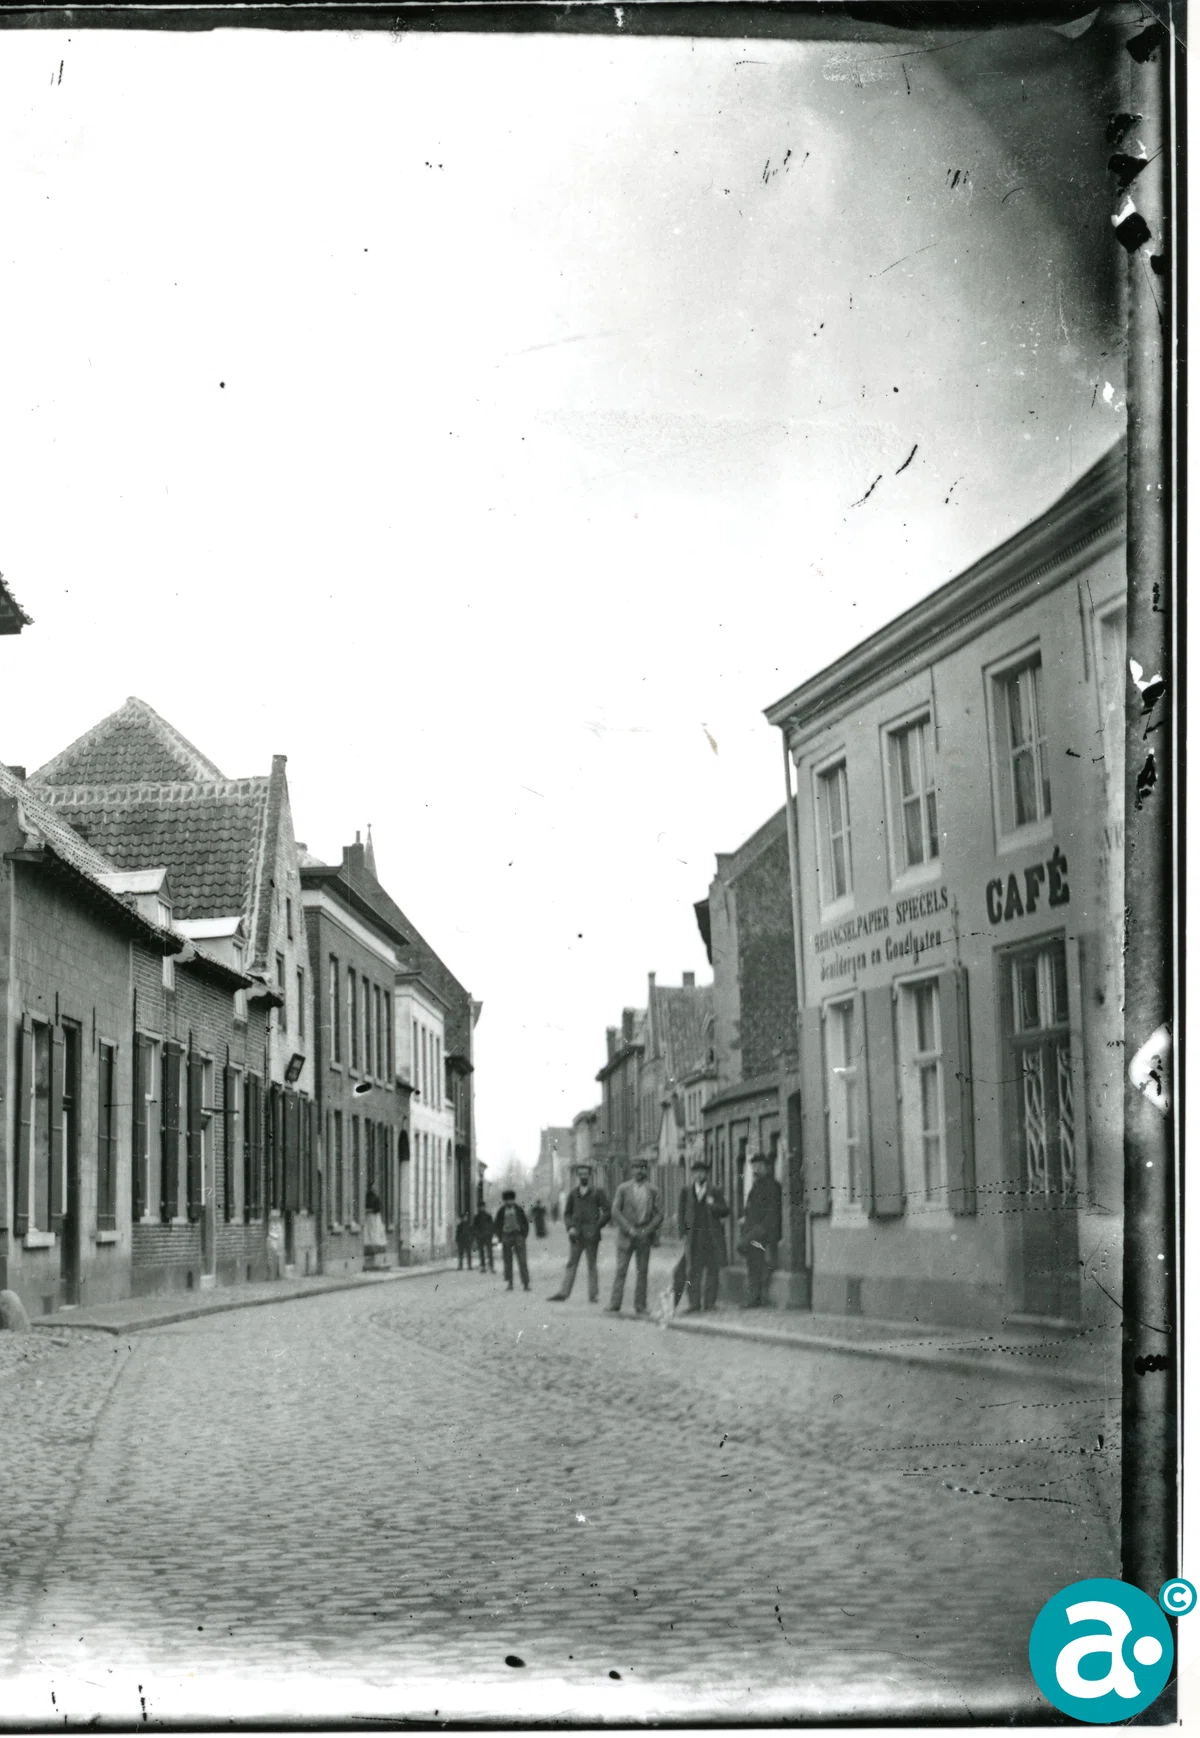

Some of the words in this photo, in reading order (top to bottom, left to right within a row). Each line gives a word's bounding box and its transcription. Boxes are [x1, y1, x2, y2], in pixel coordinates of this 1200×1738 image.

[986, 845, 1070, 925] CAFÉ
[896, 886, 949, 925] SPIEGELS
[871, 948, 881, 966] en
